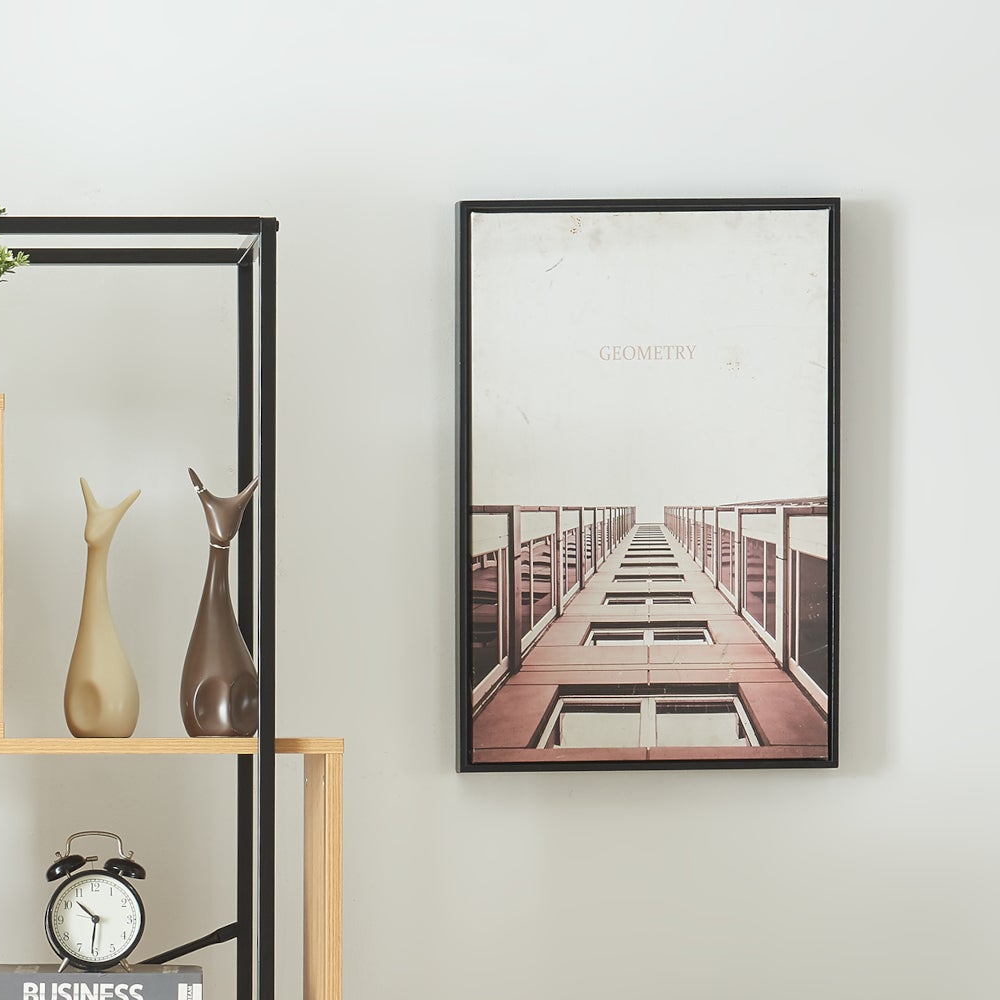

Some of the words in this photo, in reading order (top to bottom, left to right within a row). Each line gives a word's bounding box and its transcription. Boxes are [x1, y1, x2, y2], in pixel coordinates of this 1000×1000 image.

[599, 344, 697, 361] GEOMETRY
[91, 882, 100, 892] 12
[75, 888, 83, 898] 11
[63, 900, 73, 910] 10
[121, 898, 127, 908] 2
[57, 915, 64, 925] 9
[126, 915, 133, 925] 3
[63, 932, 70, 941] 8
[120, 931, 127, 940] 4
[76, 943, 83, 952] 7
[109, 943, 116, 953] 5
